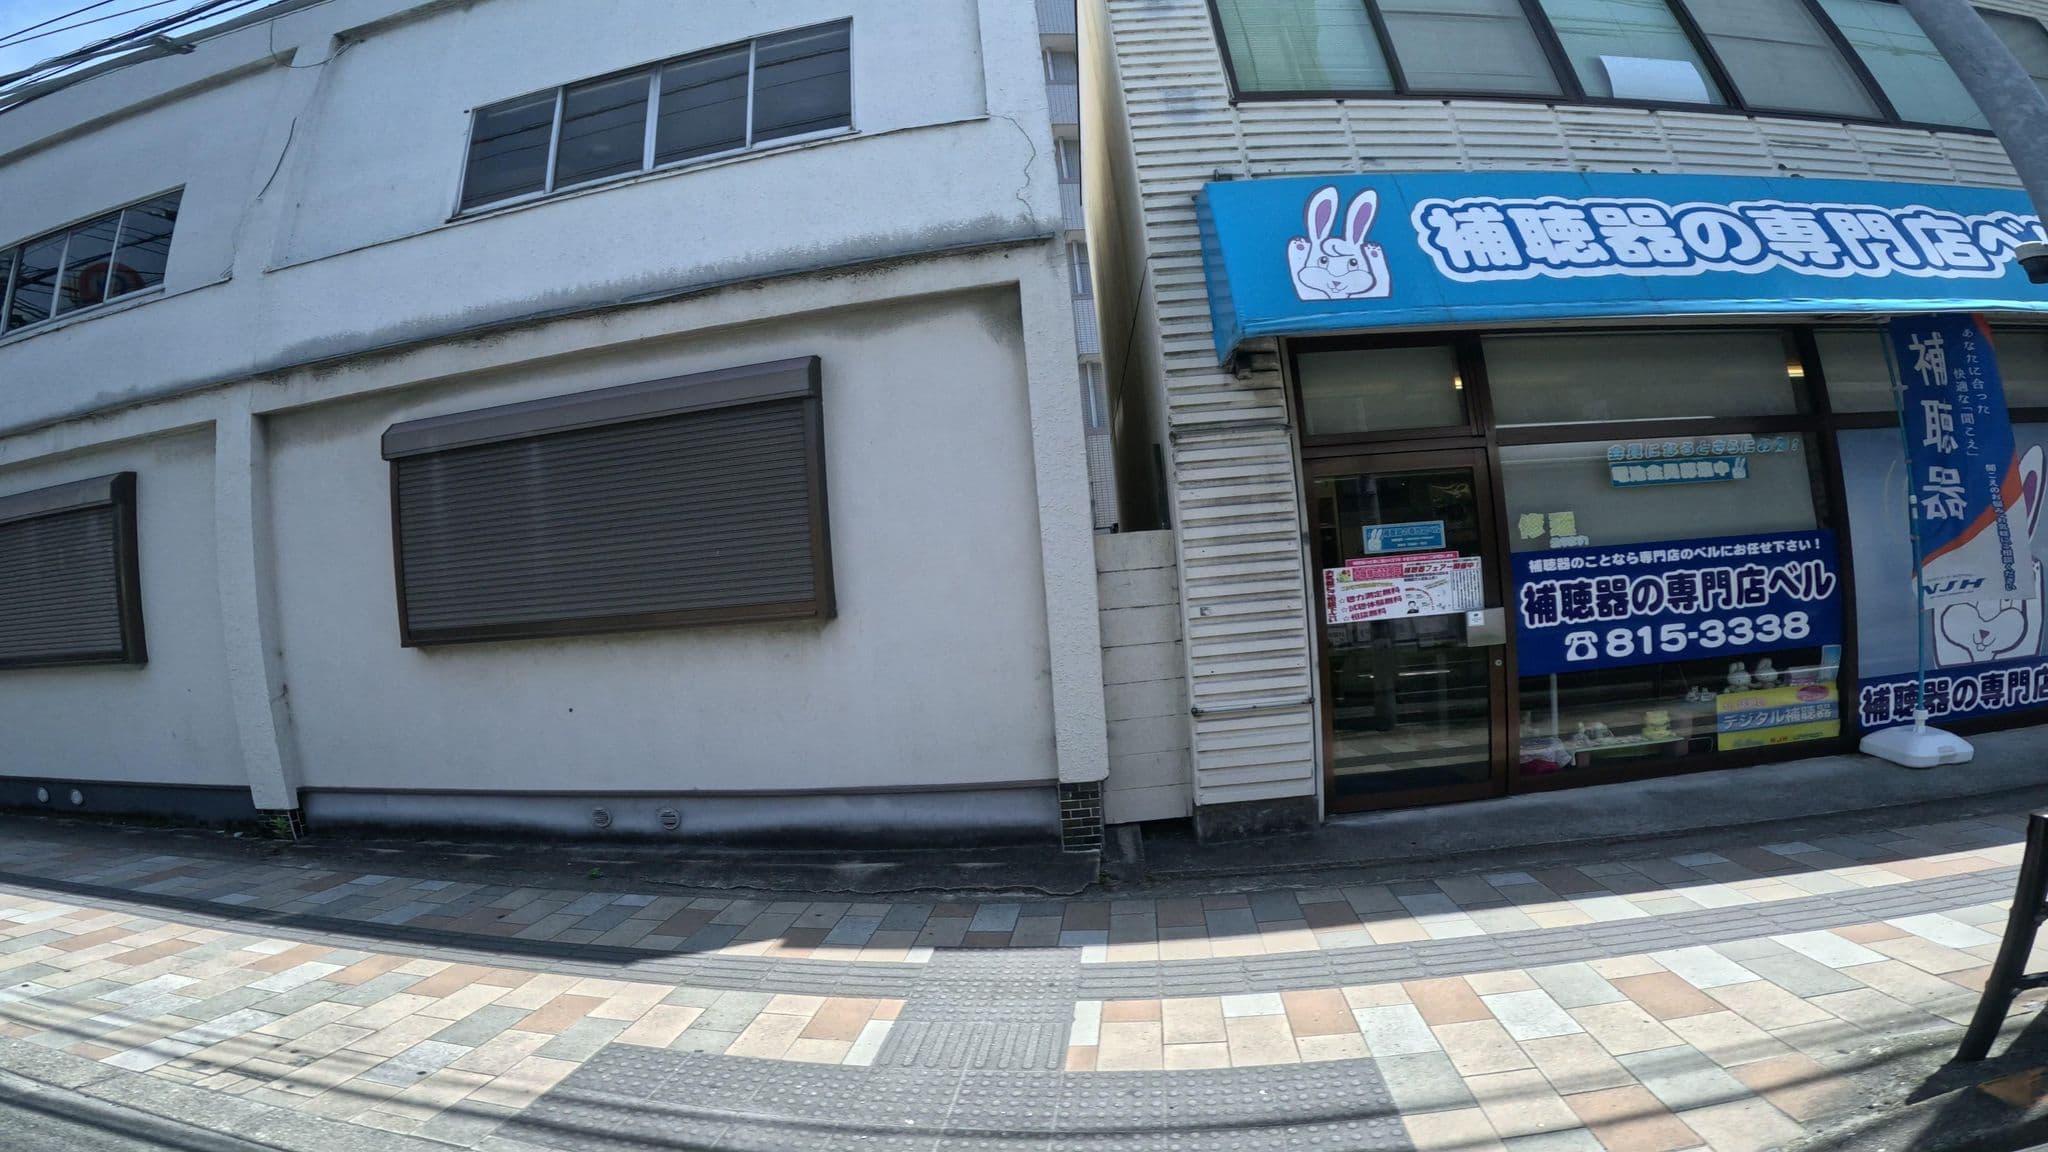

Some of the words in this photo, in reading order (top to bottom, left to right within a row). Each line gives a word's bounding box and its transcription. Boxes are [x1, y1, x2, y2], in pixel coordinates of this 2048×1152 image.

[1961, 328, 1990, 415] あなたに合った
[1908, 331, 1968, 520] 補聴器
[1521, 560, 1836, 629] 補聴器の専門店ベル
[1606, 612, 1810, 658] 815-3338
[1722, 703, 1833, 730] デジタル補聴器
